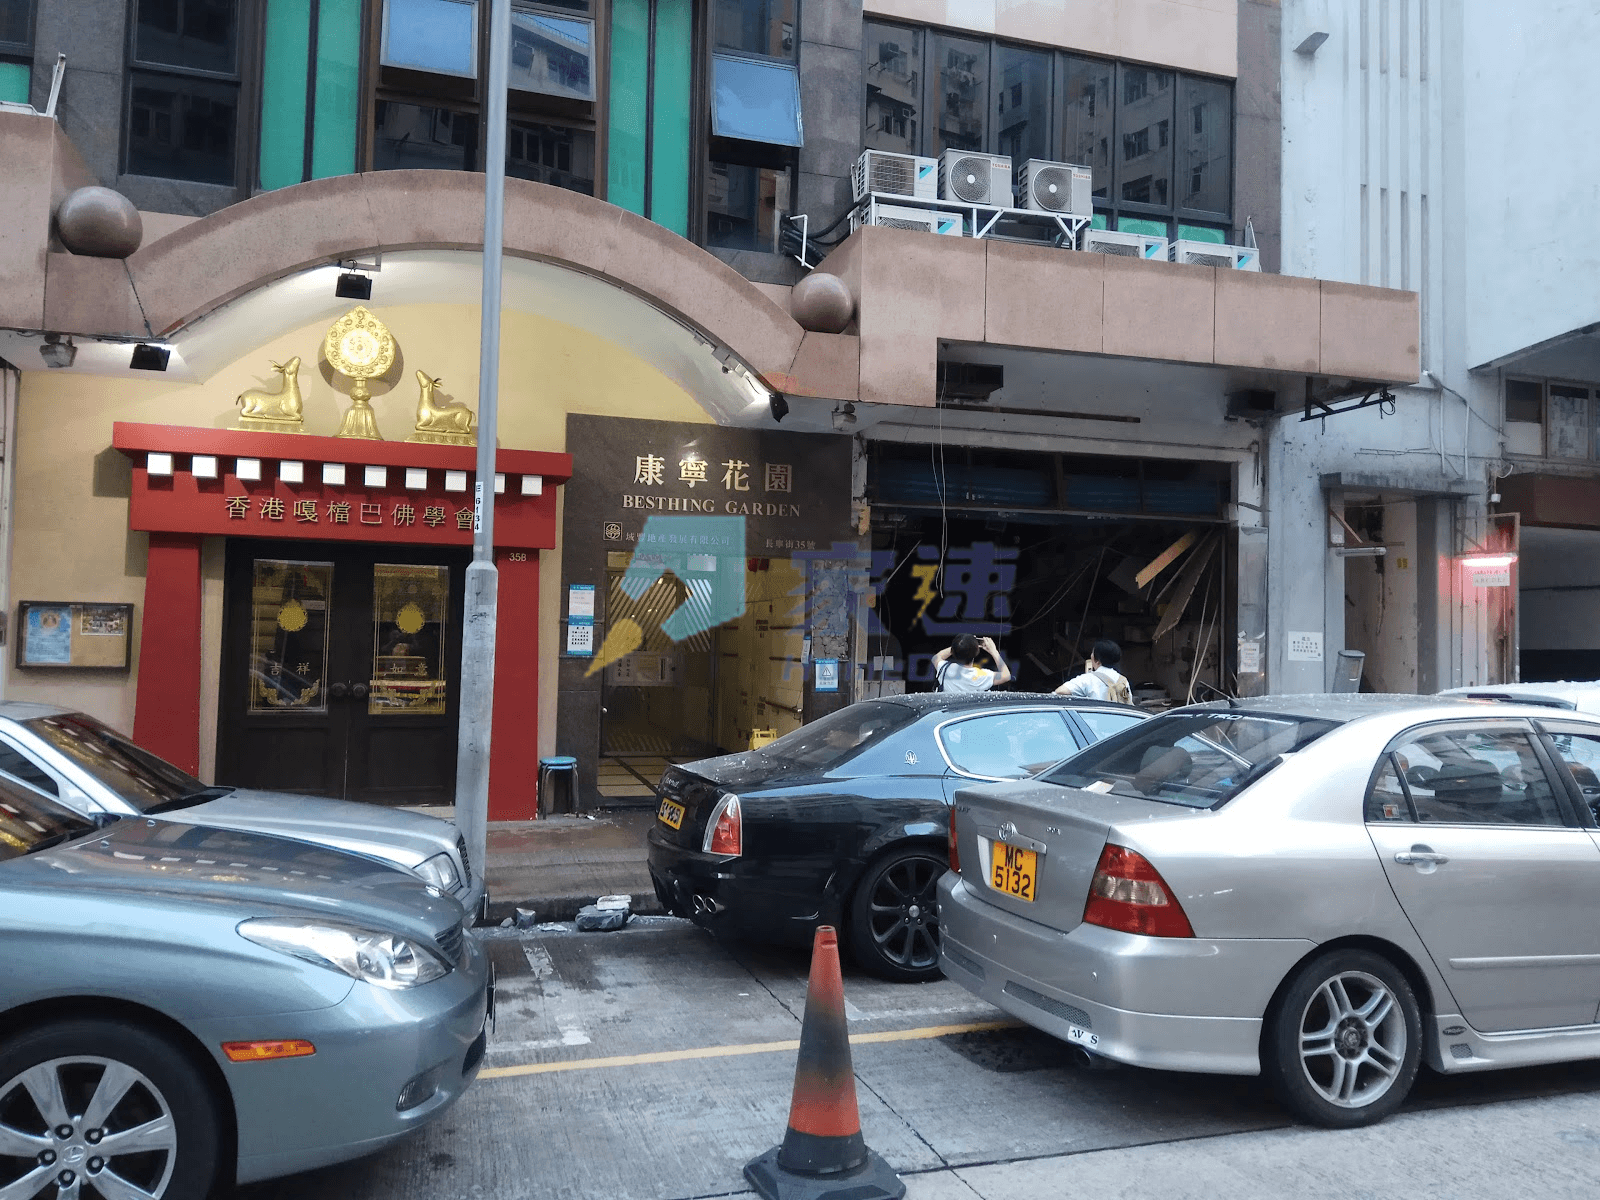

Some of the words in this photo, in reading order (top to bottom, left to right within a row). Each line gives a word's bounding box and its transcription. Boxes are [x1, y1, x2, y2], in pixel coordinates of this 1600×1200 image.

[633, 453, 793, 493] 康寧花園
[225, 495, 475, 530] 香港嘎檔巴佛學會
[622, 494, 715, 513] BESTHING
[725, 500, 800, 517] GARDEN
[1005, 844, 1024, 872] MC
[994, 865, 1031, 898] 5132
[1090, 1034, 1099, 1045] S
